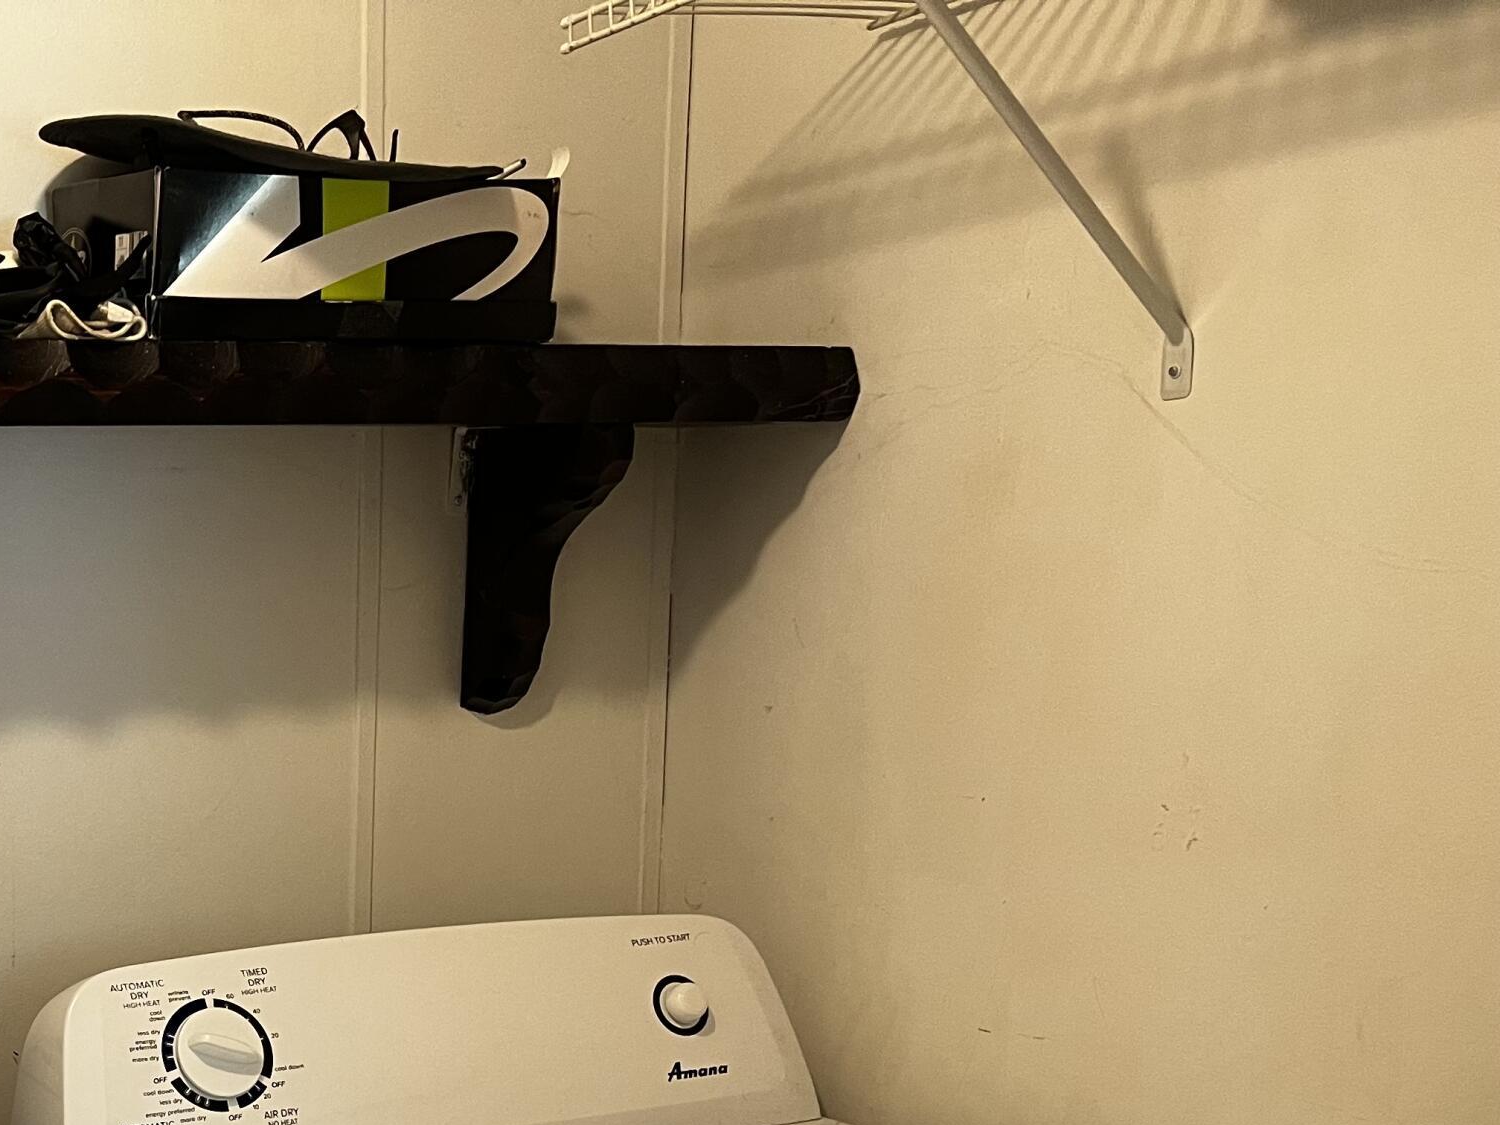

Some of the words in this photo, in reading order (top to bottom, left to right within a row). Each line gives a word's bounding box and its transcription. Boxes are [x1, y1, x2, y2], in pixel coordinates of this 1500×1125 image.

[631, 936, 654, 947] PUSH
[655, 935, 666, 944] TO
[667, 933, 690, 943] START
[240, 967, 267, 977] TIMED
[110, 979, 164, 992] AUTOMATIC
[248, 978, 266, 986] DRY
[130, 992, 149, 1000] DRY
[668, 1062, 728, 1082] Amana
[153, 1076, 167, 1084] OFF
[264, 1110, 278, 1119] AIR
[281, 1108, 299, 1117] DRY
[281, 1118, 298, 1125] HEAT
